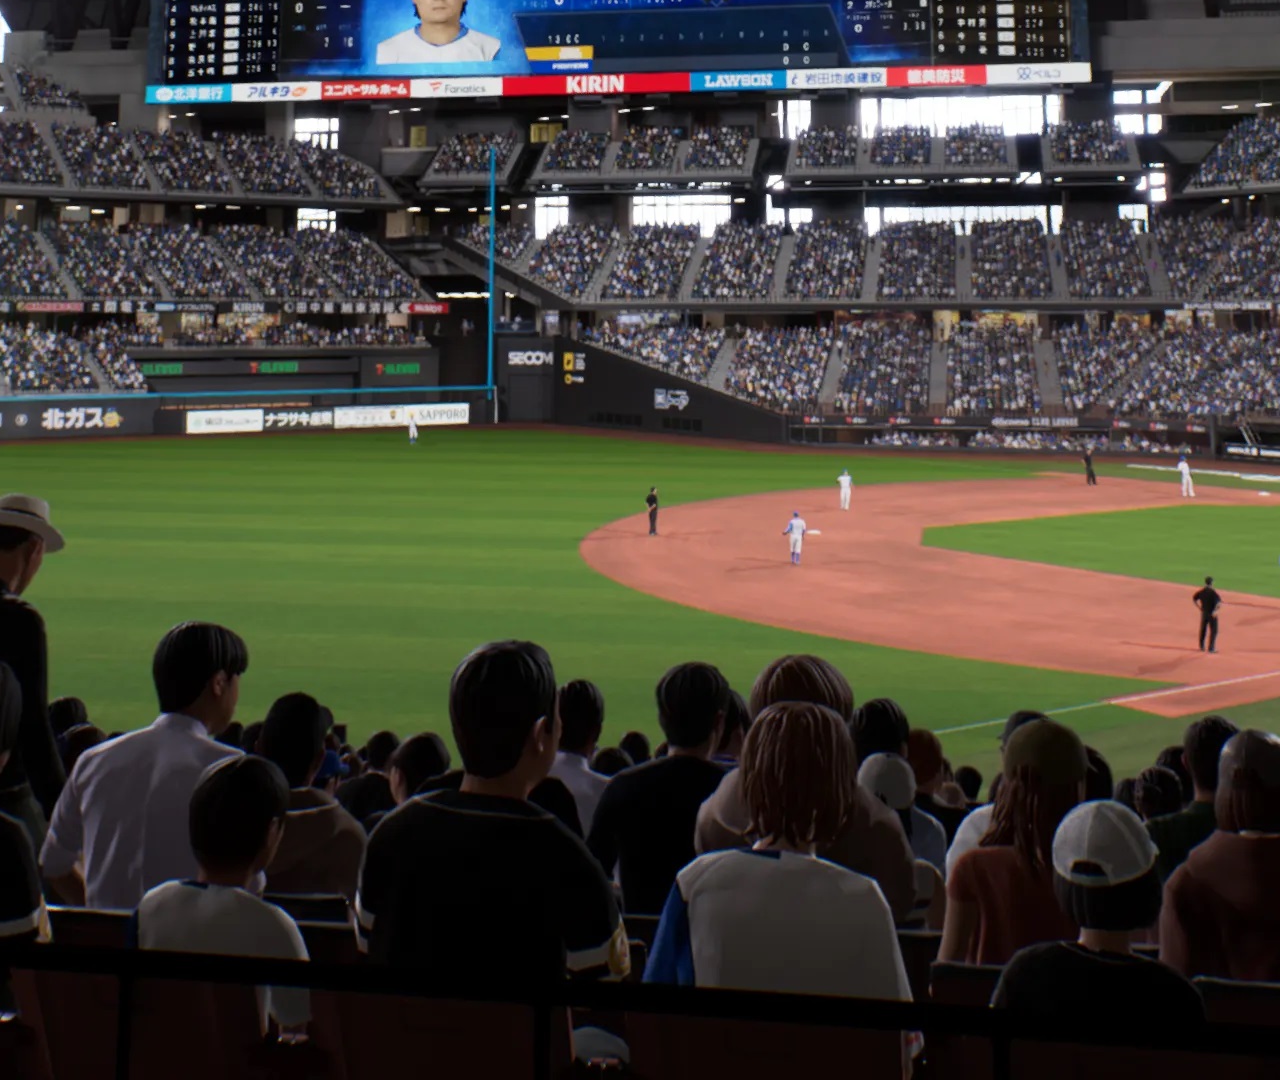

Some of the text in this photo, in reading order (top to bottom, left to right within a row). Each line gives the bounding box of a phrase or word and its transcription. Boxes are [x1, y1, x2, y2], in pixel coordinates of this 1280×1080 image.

[295, 2, 303, 13] 0
[704, 73, 773, 87] LAWSON
[805, 71, 882, 85] 岩田地崎建設
[1033, 69, 1062, 78] ベルコ
[324, 83, 408, 97] ユニバーサルホーム
[444, 83, 486, 94] Fanatics
[566, 74, 624, 93] KIRIN
[174, 87, 223, 101] 北洋銀行
[247, 86, 291, 98] アルキタ
[232, 302, 265, 312] KIRIN
[508, 351, 554, 366] SECOM
[41, 407, 104, 430] 北ガス
[419, 408, 467, 421] SAPPORO
